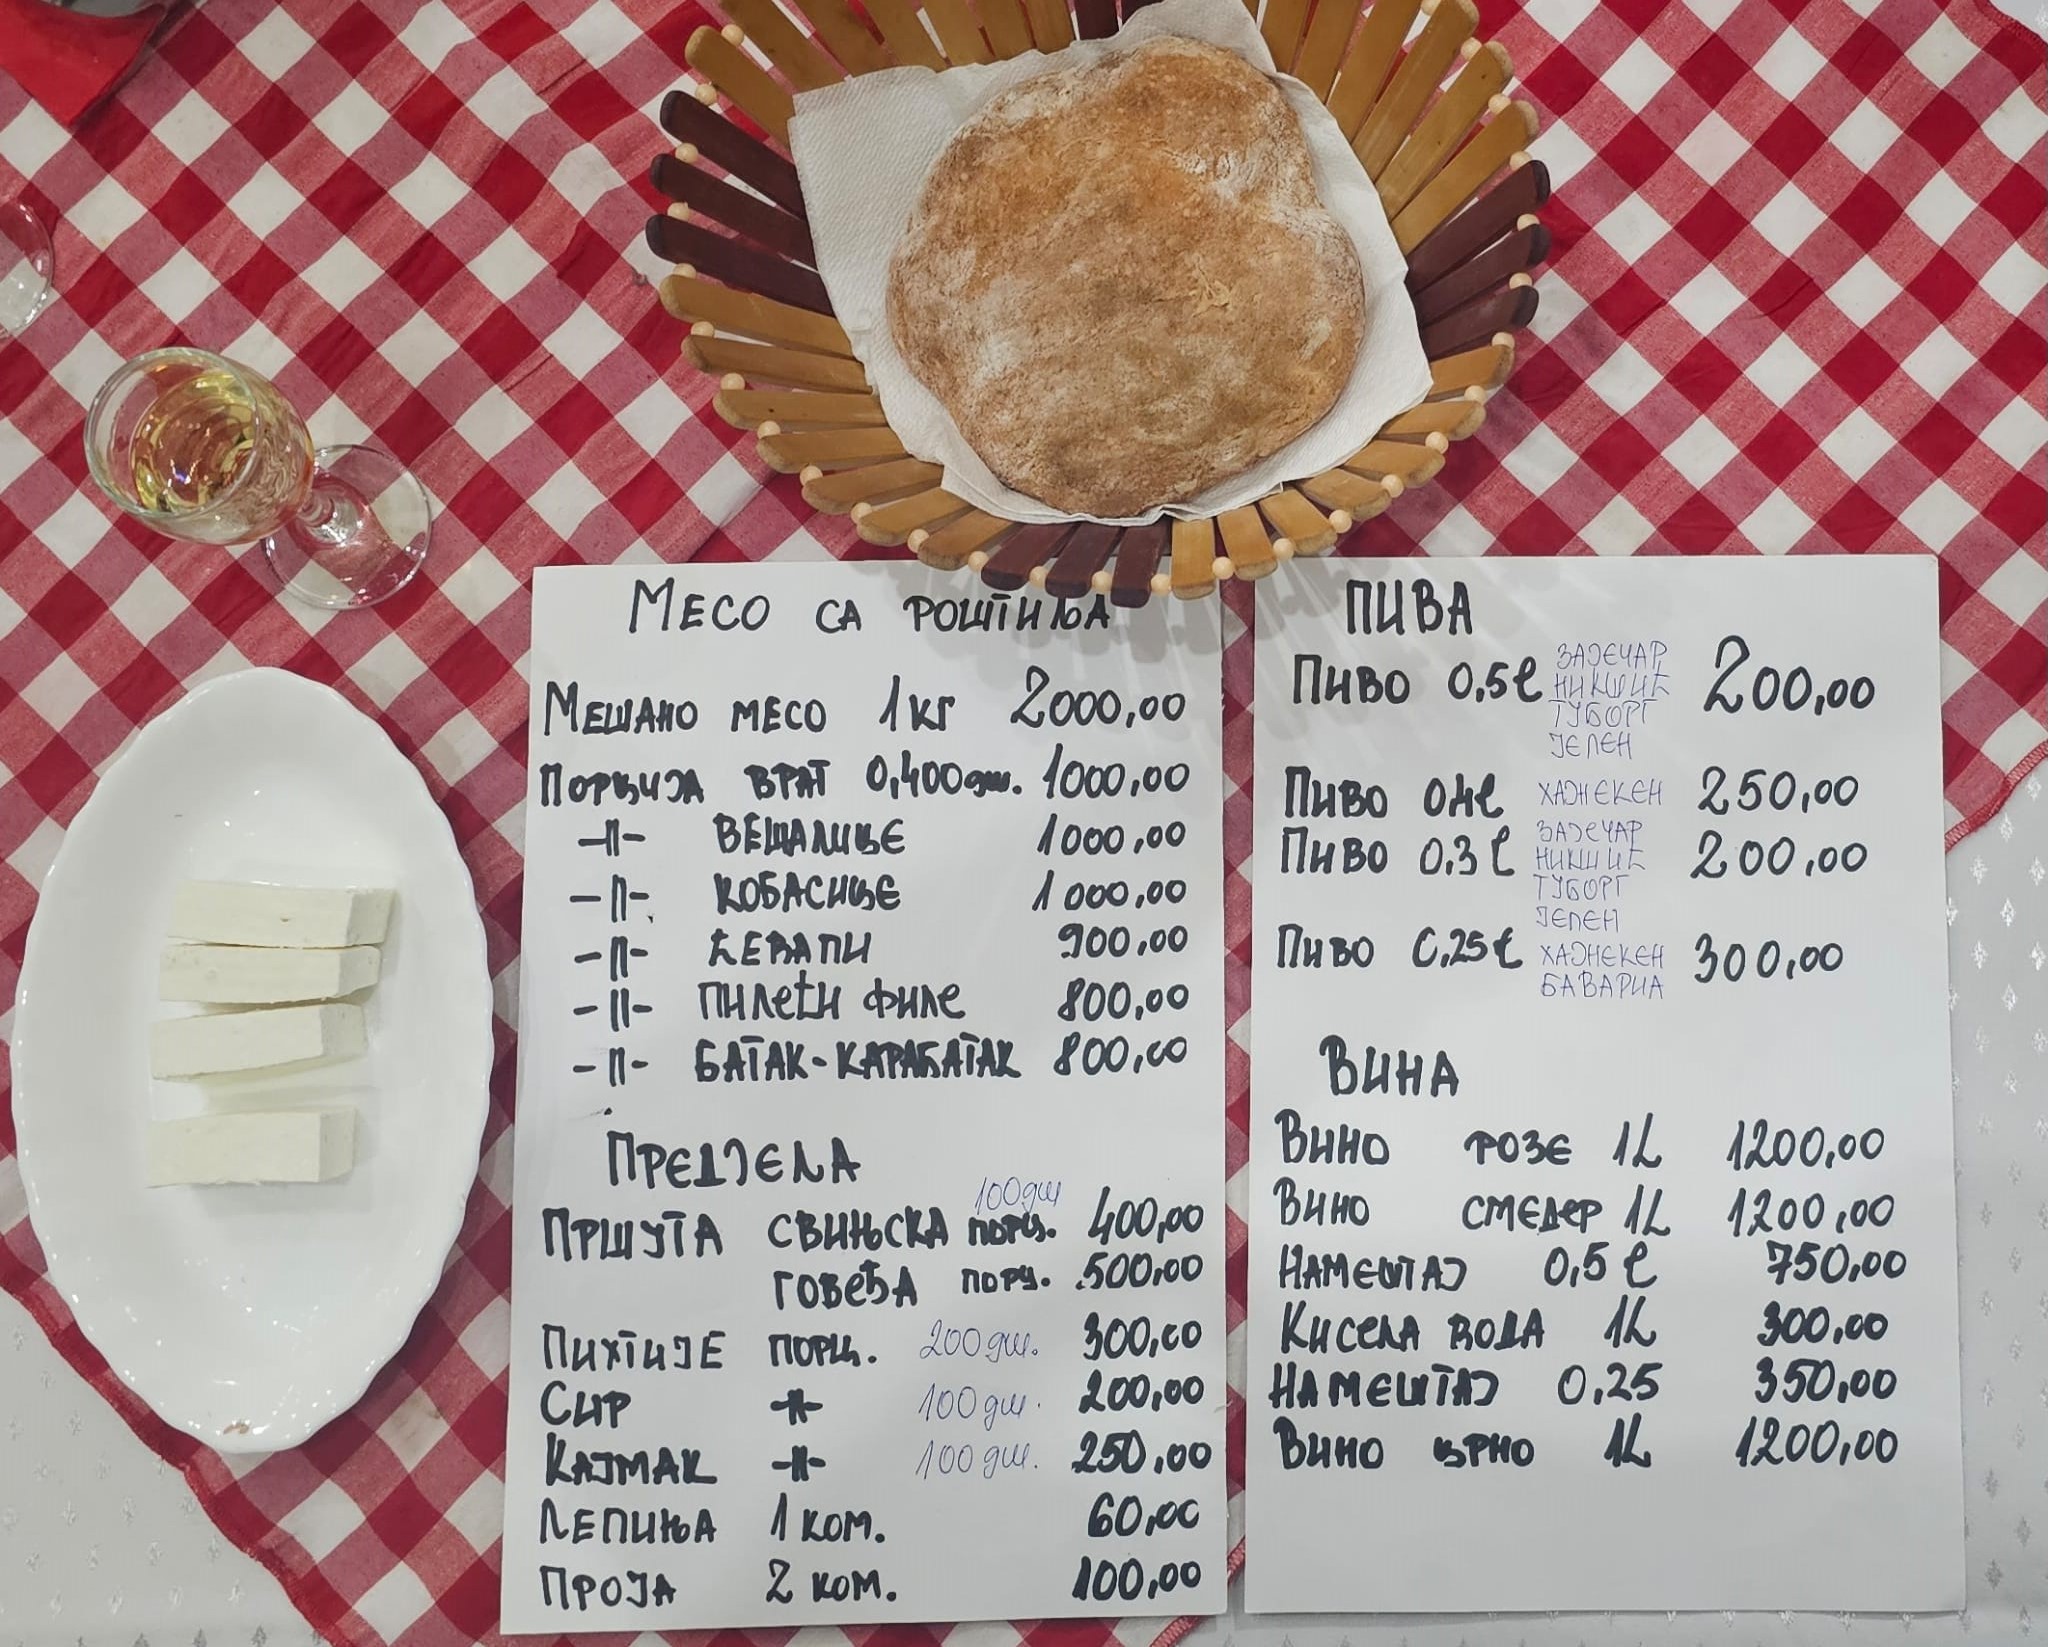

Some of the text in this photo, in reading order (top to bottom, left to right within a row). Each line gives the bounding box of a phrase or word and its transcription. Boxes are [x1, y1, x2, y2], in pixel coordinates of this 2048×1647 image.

[1009, 664, 1186, 729] 2000,00
[1703, 634, 1876, 717] 200,00
[1042, 742, 1190, 800] 1000,00
[1697, 765, 1859, 816] 250,00
[1036, 812, 1187, 856] 1000,00
[1689, 829, 1868, 879] 200,00
[1057, 922, 1189, 959] 900,00
[1694, 932, 1844, 984] 300,00
[1056, 977, 1190, 1022] 800,00
[1053, 1032, 1188, 1076] 800,00
[1726, 1118, 1885, 1172] 1200,00
[1087, 1185, 1205, 1246] 400,00
[1727, 1187, 1895, 1238] 1200,00
[1543, 1241, 1610, 1288] 0,5
[1765, 1239, 1907, 1286] 750,00
[918, 1318, 982, 1360] 200
[1082, 1311, 1203, 1361] 300,00
[1756, 1300, 1889, 1347] 300,00
[917, 1381, 978, 1422] 100
[1078, 1370, 1205, 1415] 200,00
[1557, 1361, 1664, 1406] 0,25
[1754, 1355, 1898, 1404] 350,00
[914, 1438, 975, 1480] 100
[1071, 1429, 1213, 1475] 250,00
[1734, 1415, 1899, 1468] 1200,00
[770, 1491, 788, 1542] 1
[1087, 1491, 1200, 1538] 60,00
[765, 1558, 794, 1605] 2
[1071, 1555, 1202, 1601] 100,00
